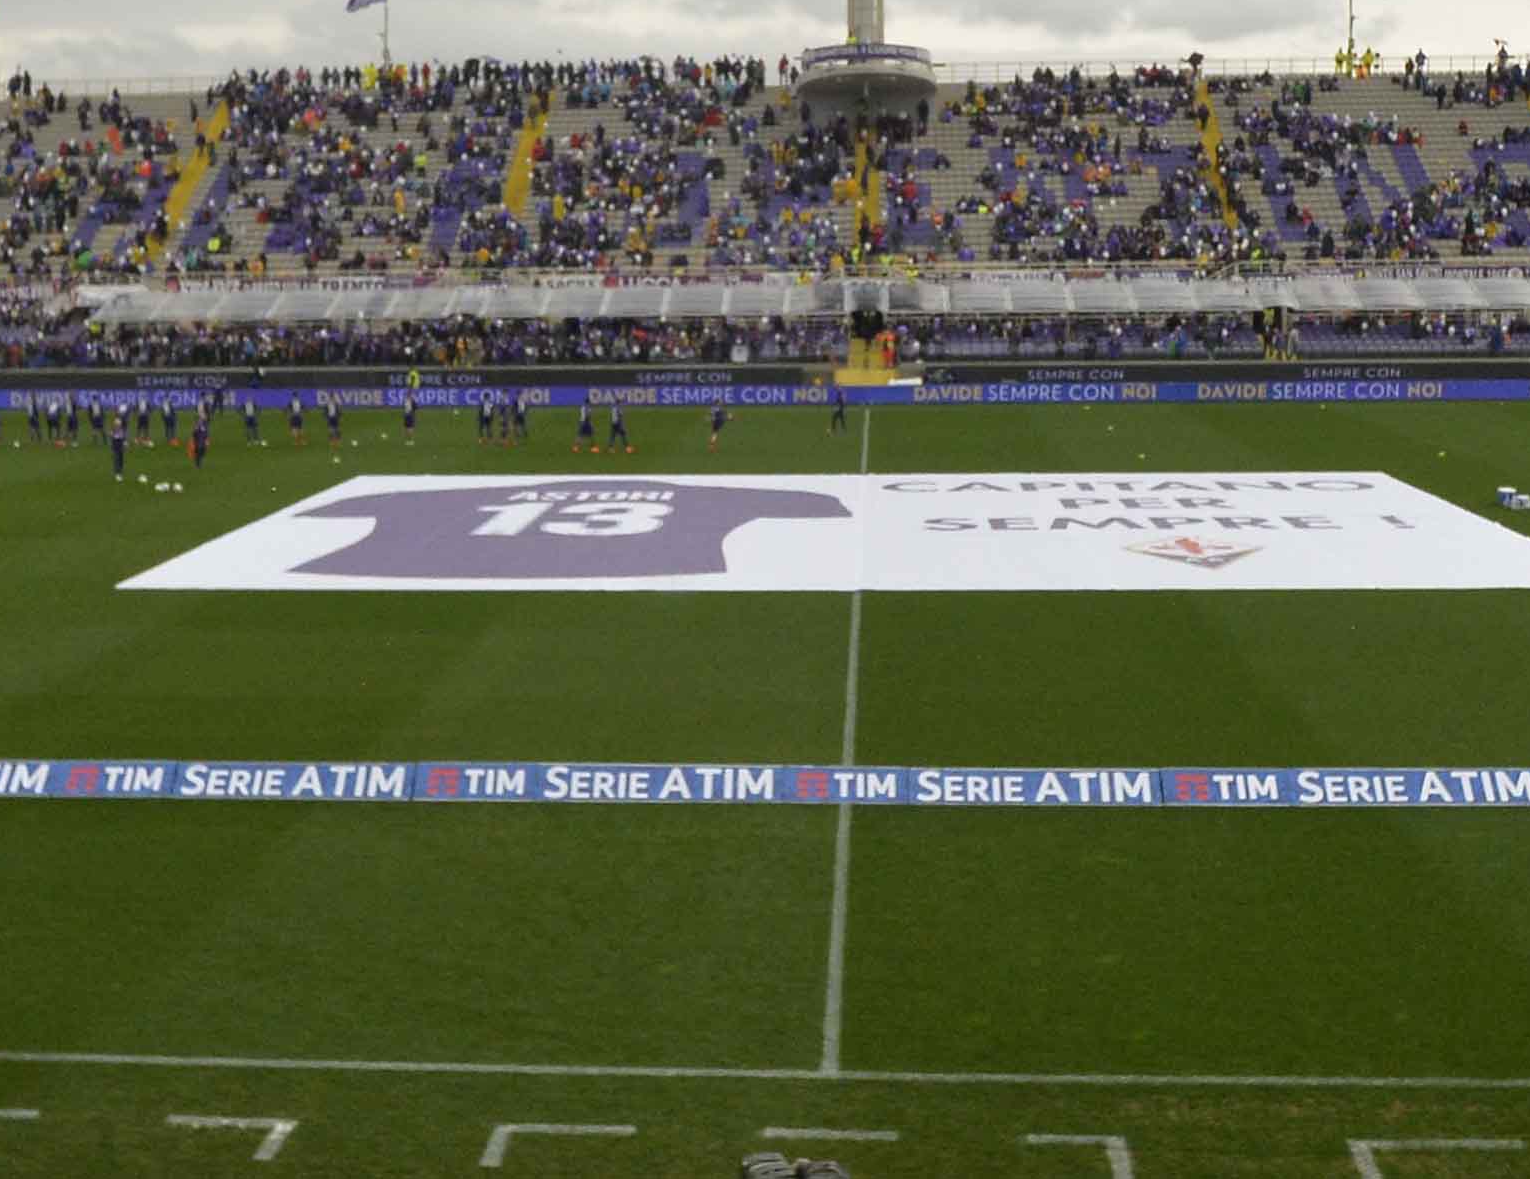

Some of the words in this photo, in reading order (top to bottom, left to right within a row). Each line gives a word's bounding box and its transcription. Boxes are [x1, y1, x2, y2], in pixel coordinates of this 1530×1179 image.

[1027, 369, 1082, 381] SEMPRE
[1089, 369, 1124, 380] CON
[1303, 367, 1359, 379] SEMPRE
[1365, 367, 1401, 378] CON
[588, 387, 657, 405] DAVIDE
[661, 387, 735, 405] SEMPRE
[741, 387, 787, 404] CON
[793, 387, 829, 403] NOI
[912, 385, 983, 402] DAVIDE
[987, 384, 1061, 402] SEMPRE
[1068, 384, 1115, 401] CON
[1121, 384, 1157, 400] NOI
[1196, 383, 1267, 399] DAVIDE
[1272, 383, 1347, 399] SEMPRE
[1353, 383, 1400, 399] CON
[1406, 383, 1442, 398] NOI
[880, 478, 1378, 494] CAPITANO
[507, 490, 675, 503] ASTORI
[1056, 496, 1238, 511] PER
[469, 502, 674, 537] 13
[921, 515, 1345, 532] SEMPRE
[102, 765, 164, 792] TIM
[179, 763, 285, 797] SERIE
[330, 765, 408, 799] TIM
[463, 768, 527, 795] TIM
[543, 766, 651, 800] SERIE
[694, 767, 775, 801] TIM
[832, 771, 898, 799] TIM
[915, 769, 1026, 803] SERIE
[1070, 770, 1153, 804] TIM
[1211, 773, 1280, 801] TIM
[1296, 771, 1410, 804] SERIE
